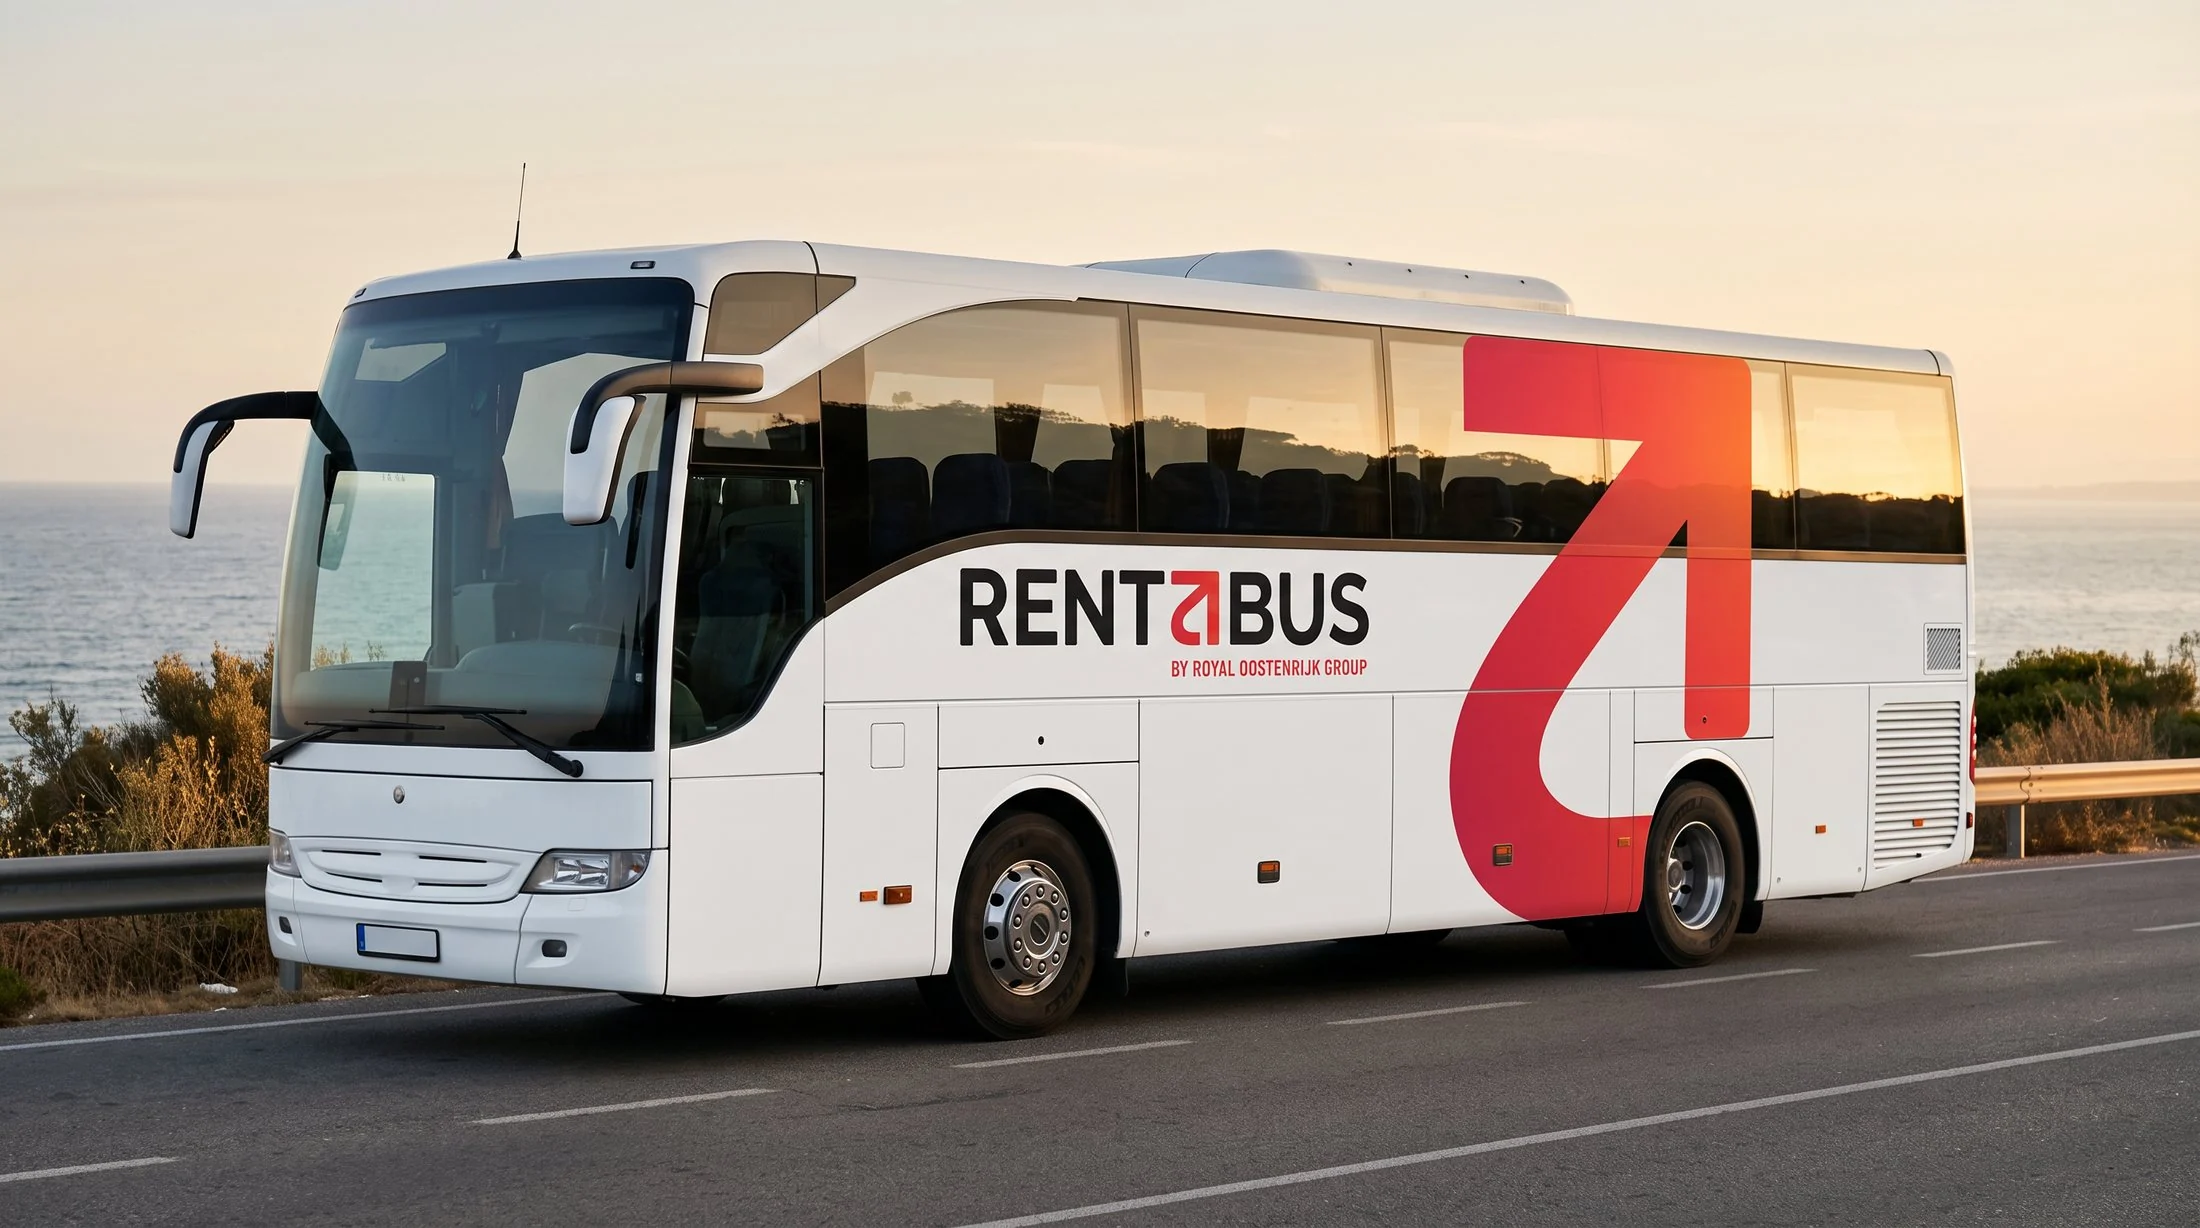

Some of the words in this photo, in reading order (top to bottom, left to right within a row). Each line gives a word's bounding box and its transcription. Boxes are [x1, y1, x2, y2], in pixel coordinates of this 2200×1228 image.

[1171, 660, 1188, 678] BY
[1193, 660, 1235, 677] ROYAL
[1239, 659, 1320, 677] OOSTENRIJK
[1324, 659, 1368, 676] GROUP
